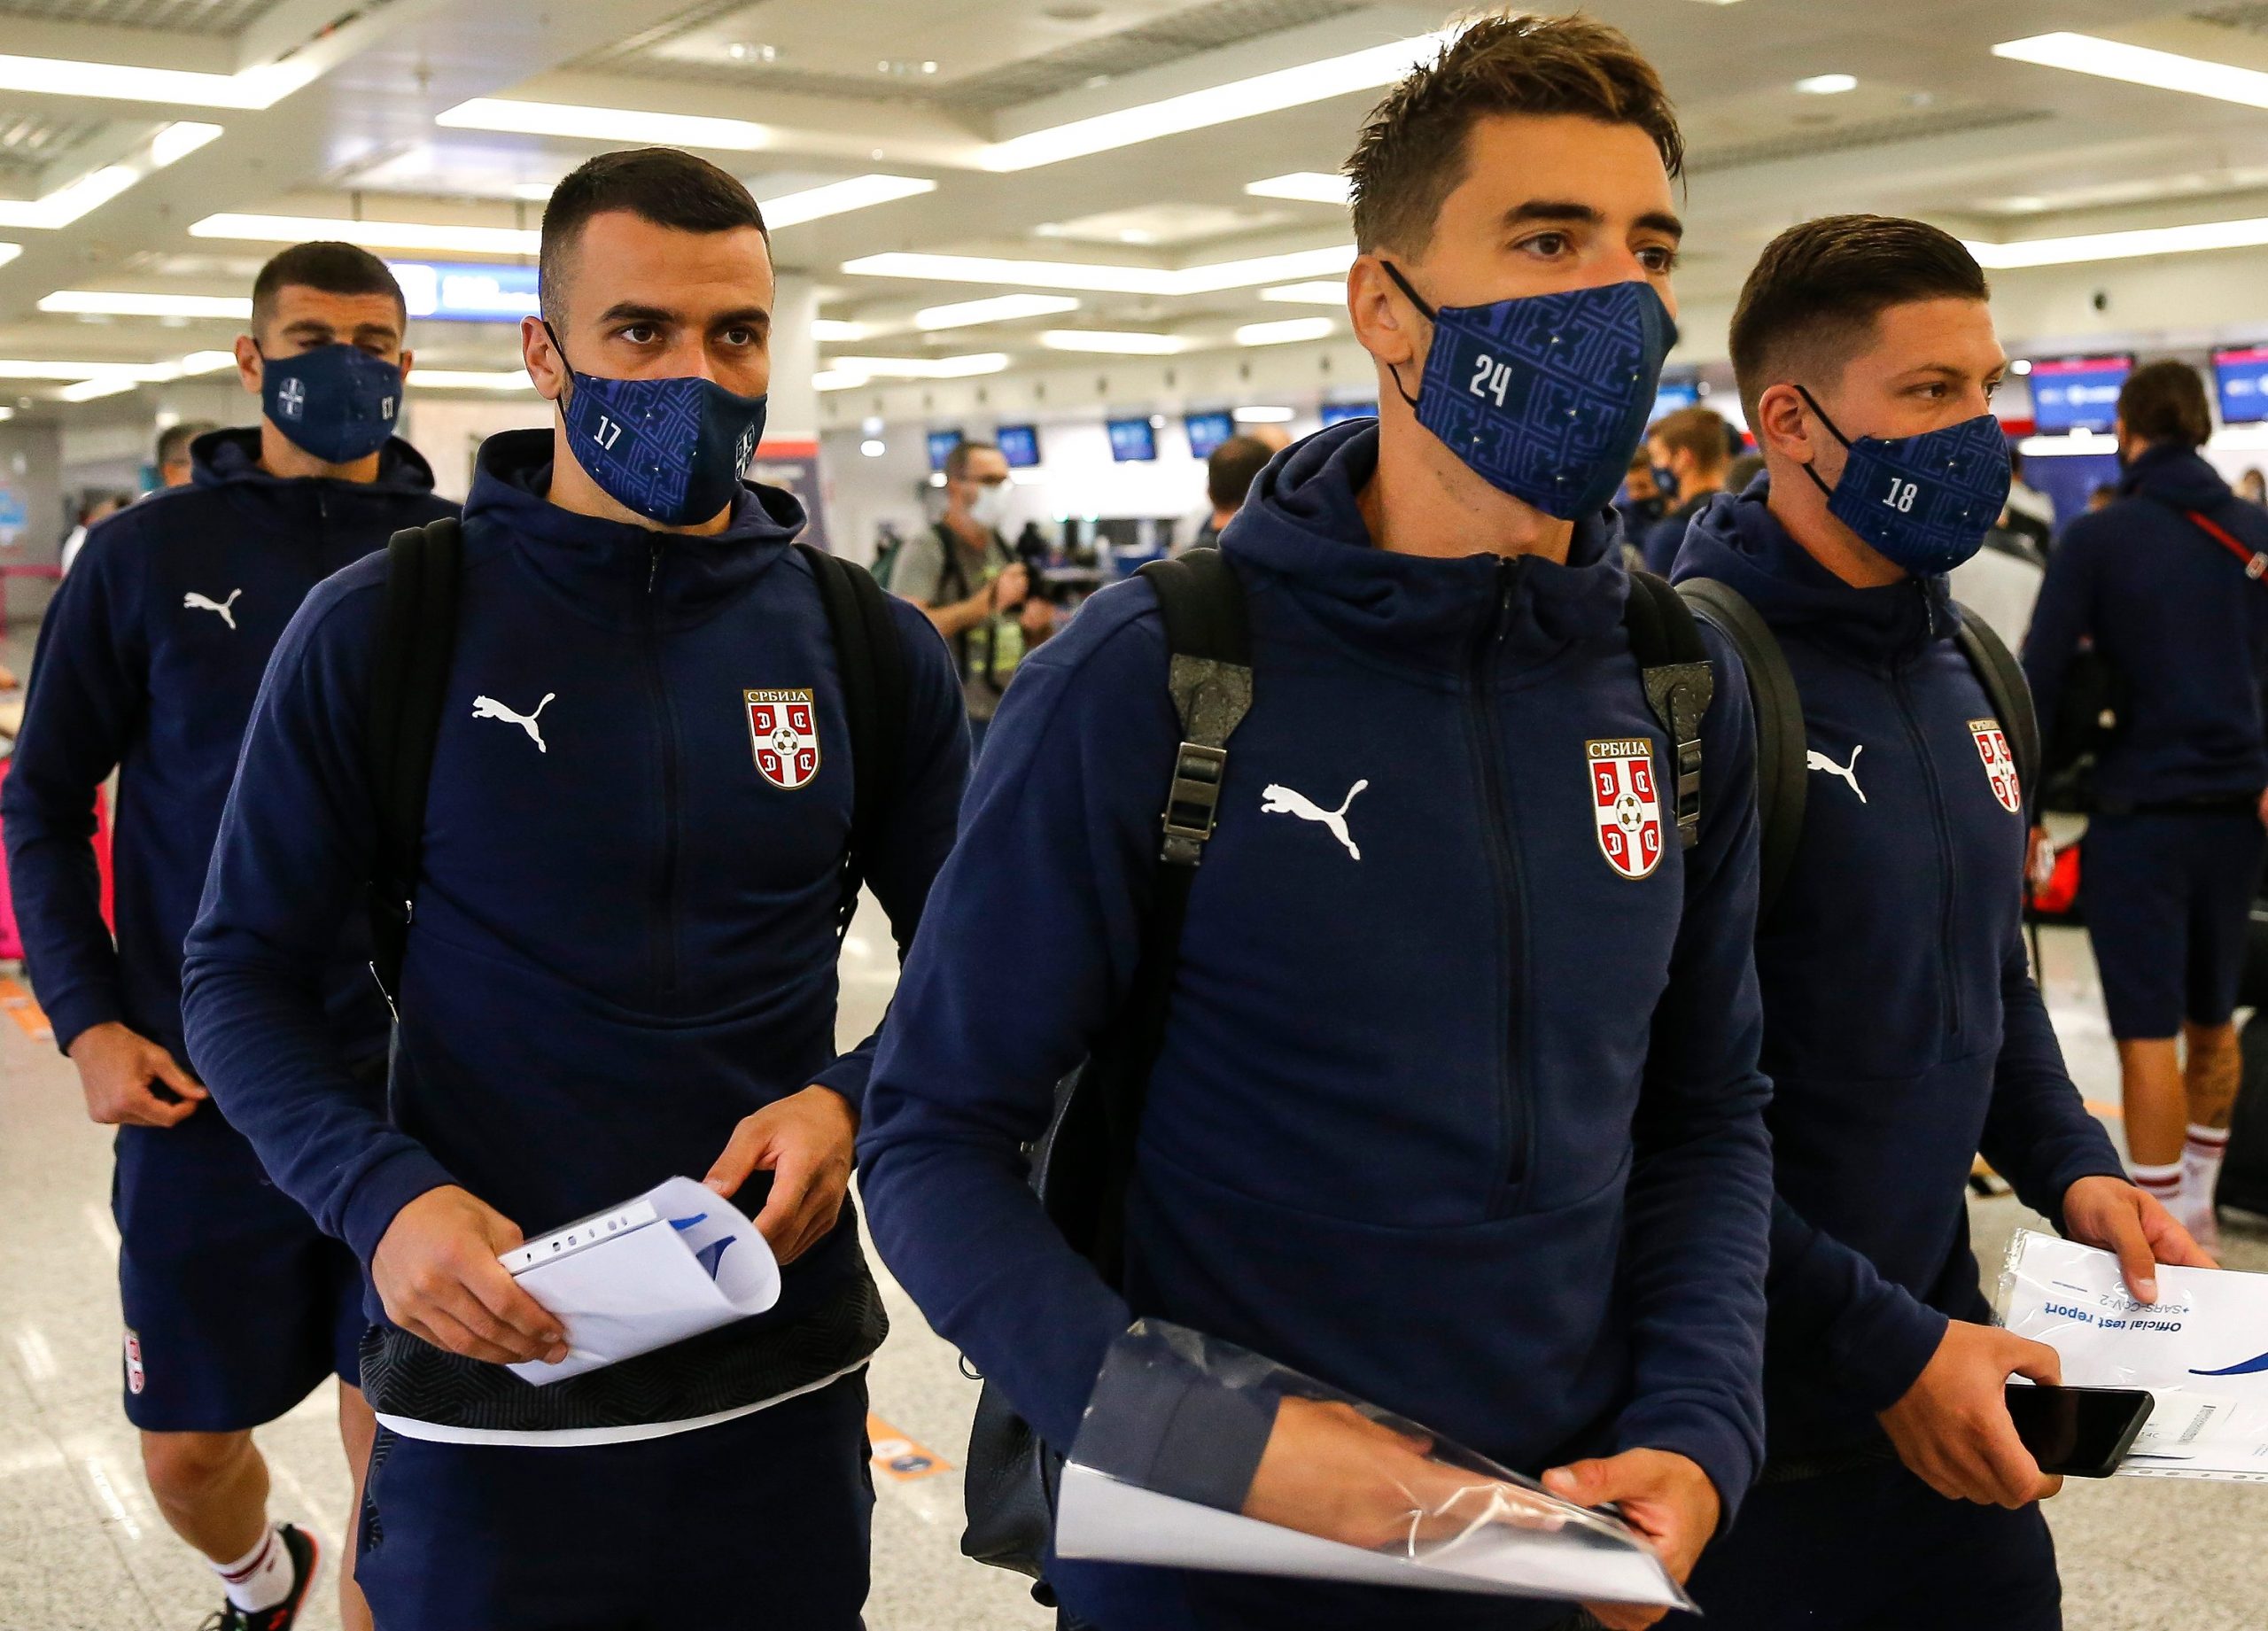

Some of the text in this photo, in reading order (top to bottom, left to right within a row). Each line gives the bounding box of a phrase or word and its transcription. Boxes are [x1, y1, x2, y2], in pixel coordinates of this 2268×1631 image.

[1470, 353, 1511, 407] 24
[594, 415, 622, 450] 17
[1883, 478, 1918, 512] 18
[747, 691, 809, 702] СРБИЈА
[1588, 742, 1649, 757] СРБИЈА
[2045, 1301, 2181, 1332] Official test report
